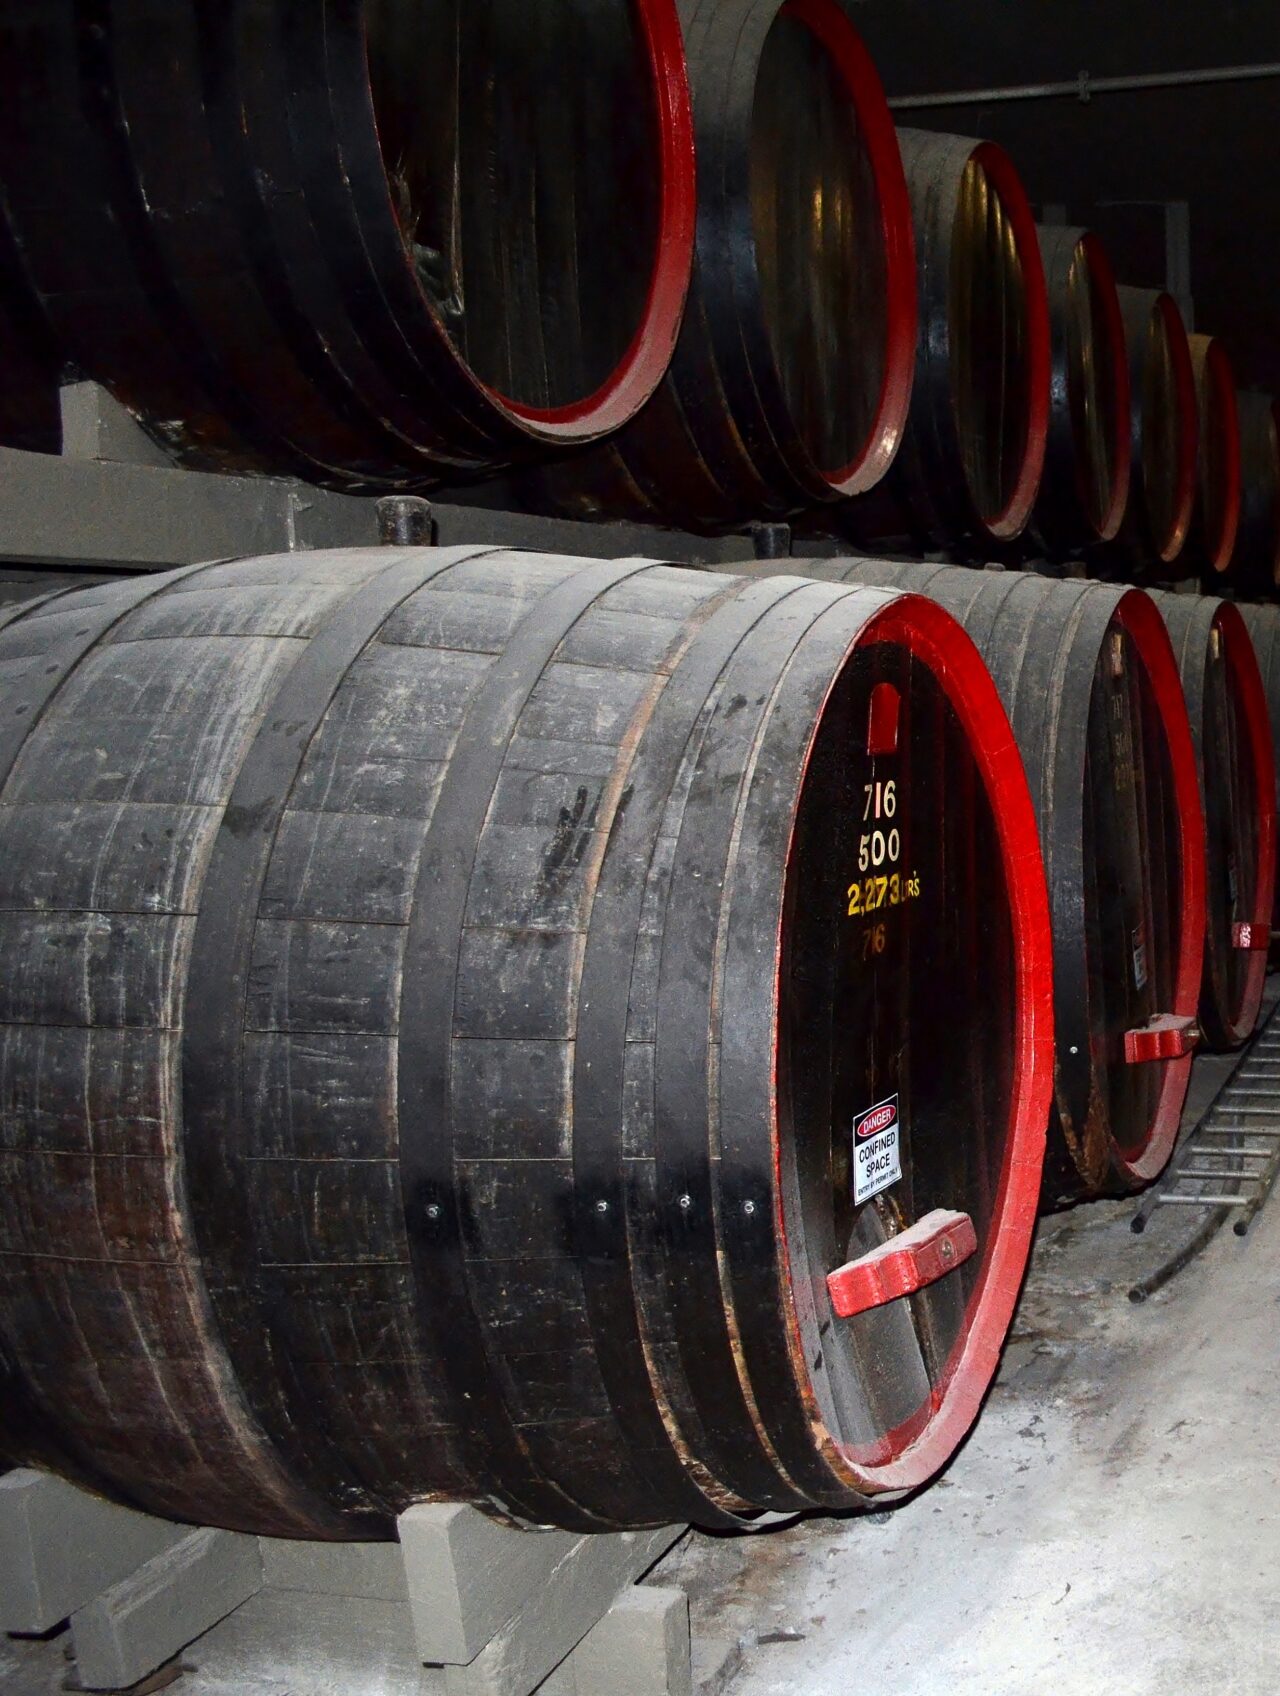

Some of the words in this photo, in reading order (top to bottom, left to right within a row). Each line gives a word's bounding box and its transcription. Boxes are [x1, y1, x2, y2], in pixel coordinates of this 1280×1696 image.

[862, 780, 897, 822] 716
[858, 828, 900, 872] 500
[847, 873, 900, 917] 2,273
[863, 1110, 891, 1134] DANGER
[859, 1132, 896, 1163] CONFINED
[866, 1153, 891, 1178] SPACE
[875, 1173, 889, 1186] PERMIT
